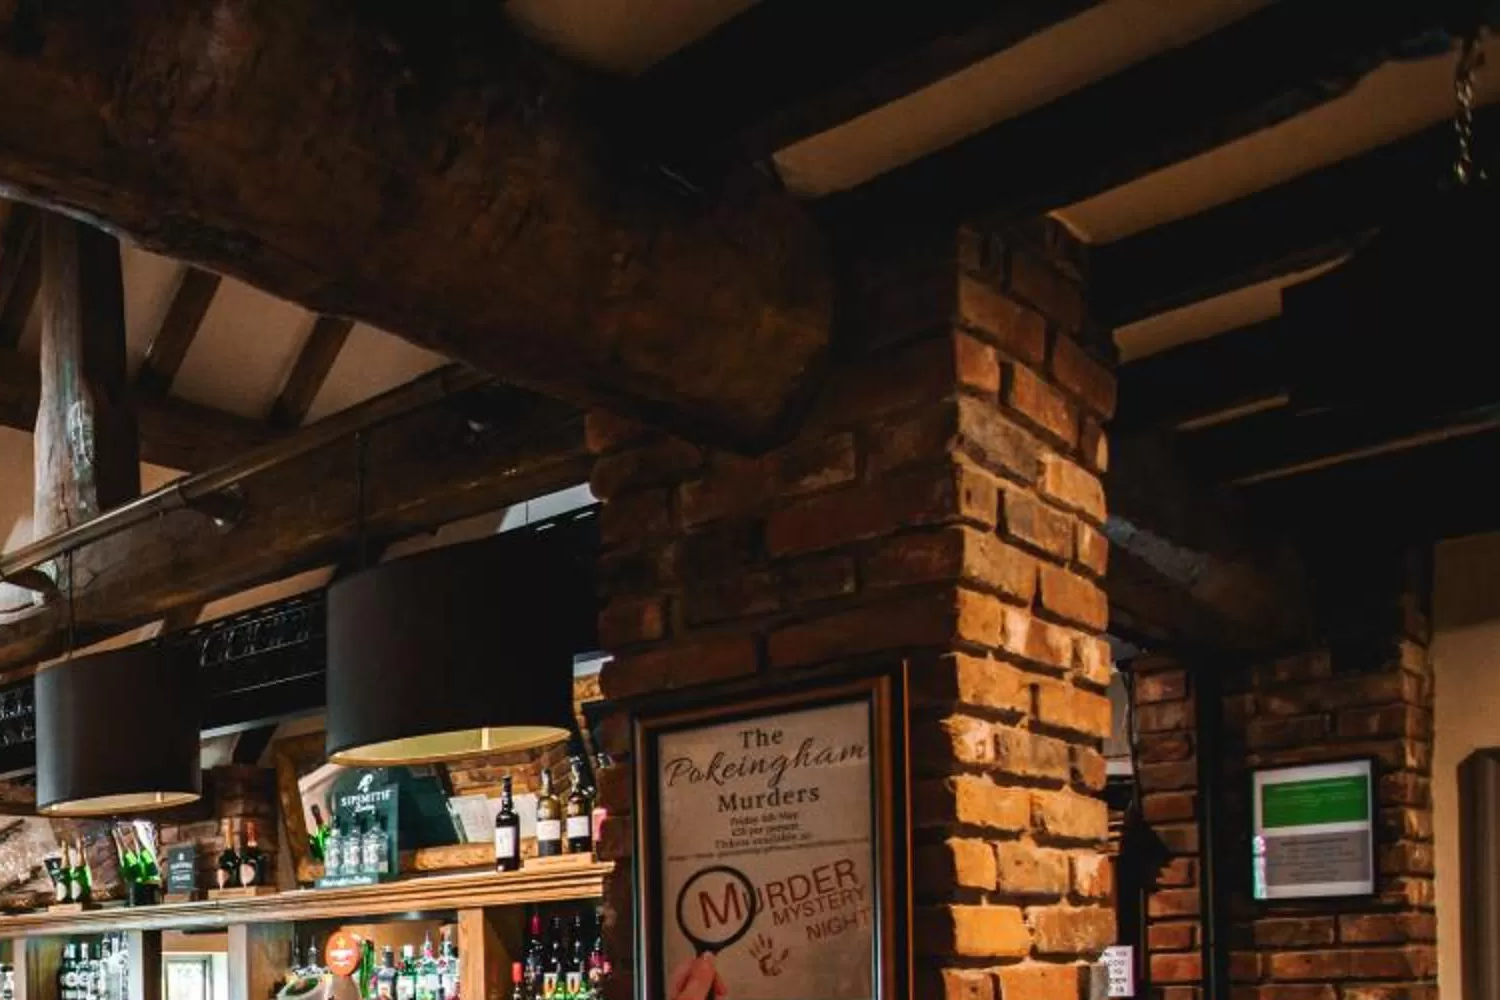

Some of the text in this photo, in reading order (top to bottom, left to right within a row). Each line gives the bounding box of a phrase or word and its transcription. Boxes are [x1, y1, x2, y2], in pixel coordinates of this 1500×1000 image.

[738, 728, 784, 749] The
[717, 785, 821, 813] Murders
[698, 858, 859, 929] MURDER
[772, 885, 866, 926] MYSTERY
[806, 908, 870, 941] NIGHT
